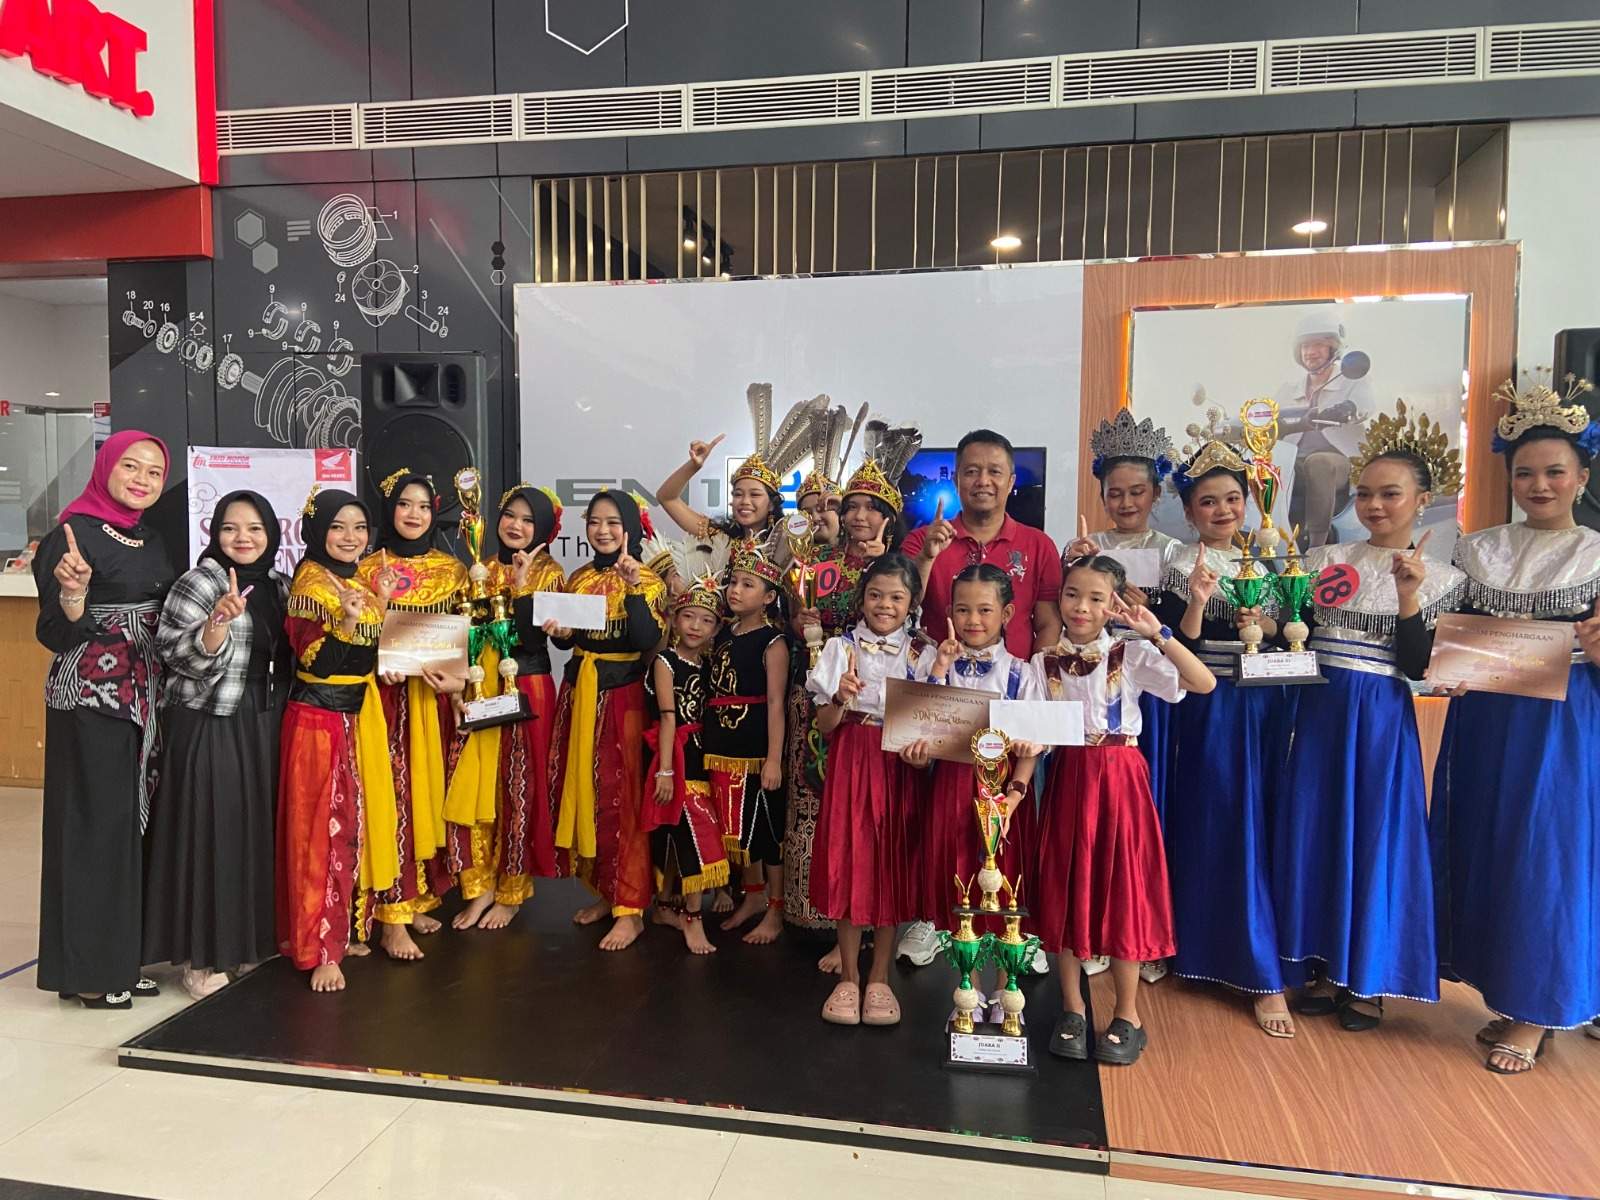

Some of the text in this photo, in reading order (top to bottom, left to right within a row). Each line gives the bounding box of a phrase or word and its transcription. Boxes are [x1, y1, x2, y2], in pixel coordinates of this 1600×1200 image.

[413, 265, 419, 274] 2
[269, 284, 275, 293] 9
[126, 290, 136, 299] 18
[334, 293, 346, 303] 24
[421, 290, 428, 299] 3
[143, 300, 154, 309] 20
[160, 303, 170, 312] 16
[301, 302, 307, 311] 9
[437, 306, 449, 315] 24
[189, 312, 204, 321] E-4
[333, 320, 339, 329] 9
[248, 328, 254, 338] 9
[222, 334, 233, 343] 17
[281, 341, 288, 350] 9
[557, 536, 589, 557] Th
[1316, 566, 1352, 604] 18
